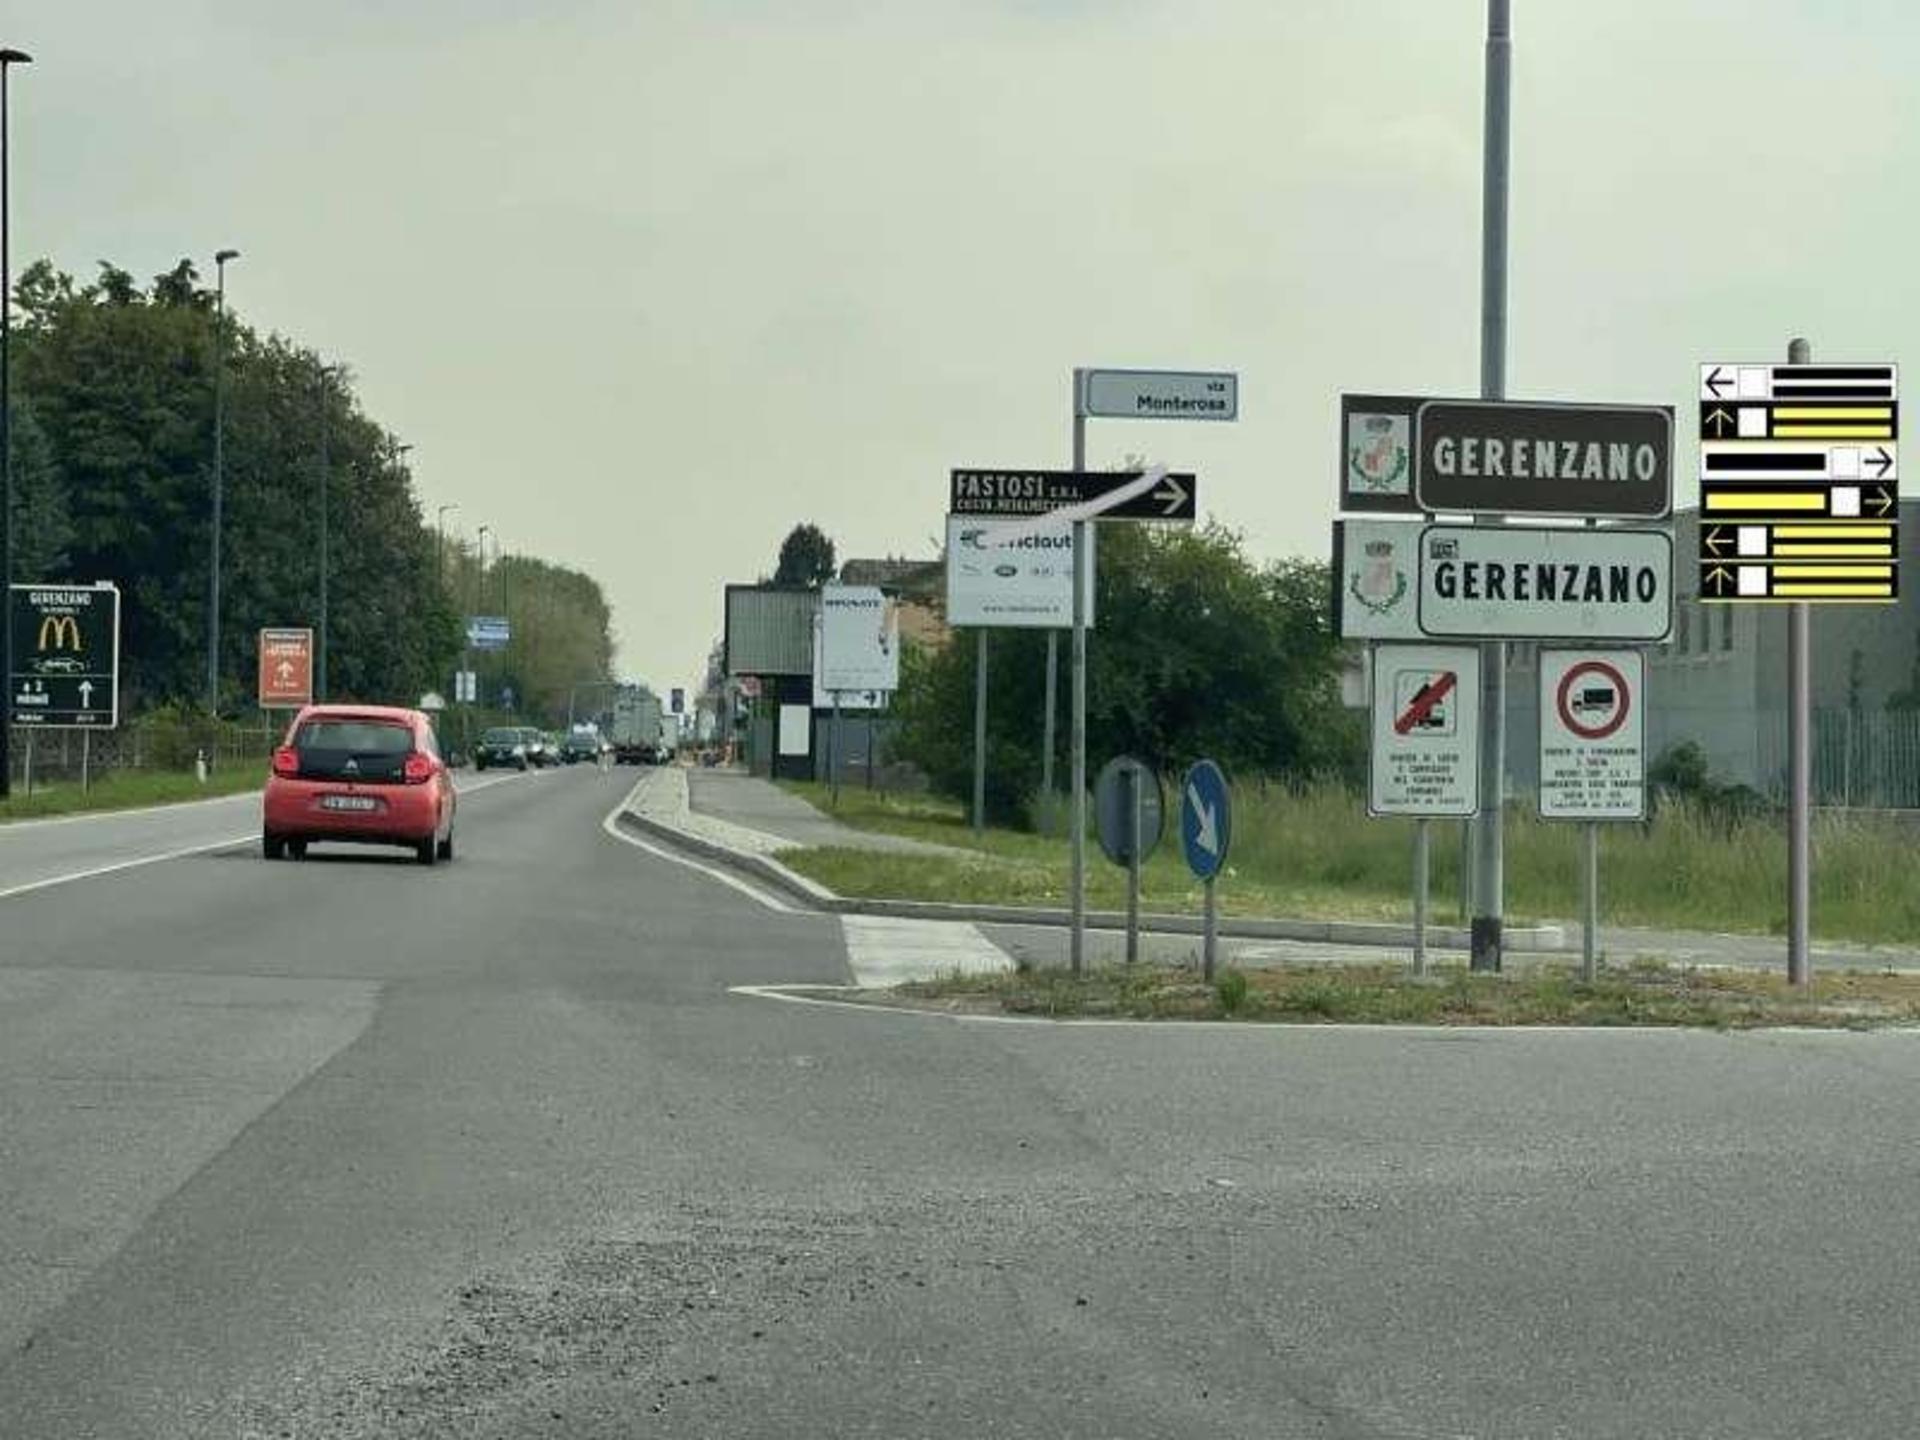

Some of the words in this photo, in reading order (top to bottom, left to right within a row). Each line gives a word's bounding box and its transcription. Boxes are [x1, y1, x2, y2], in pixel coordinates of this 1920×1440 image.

[1206, 382, 1225, 392] via
[1137, 395, 1225, 411] Monterosa
[1433, 437, 1656, 480] GERENZANO
[956, 474, 1044, 497] FASTOSI
[1434, 562, 1656, 602] GERENZANO
